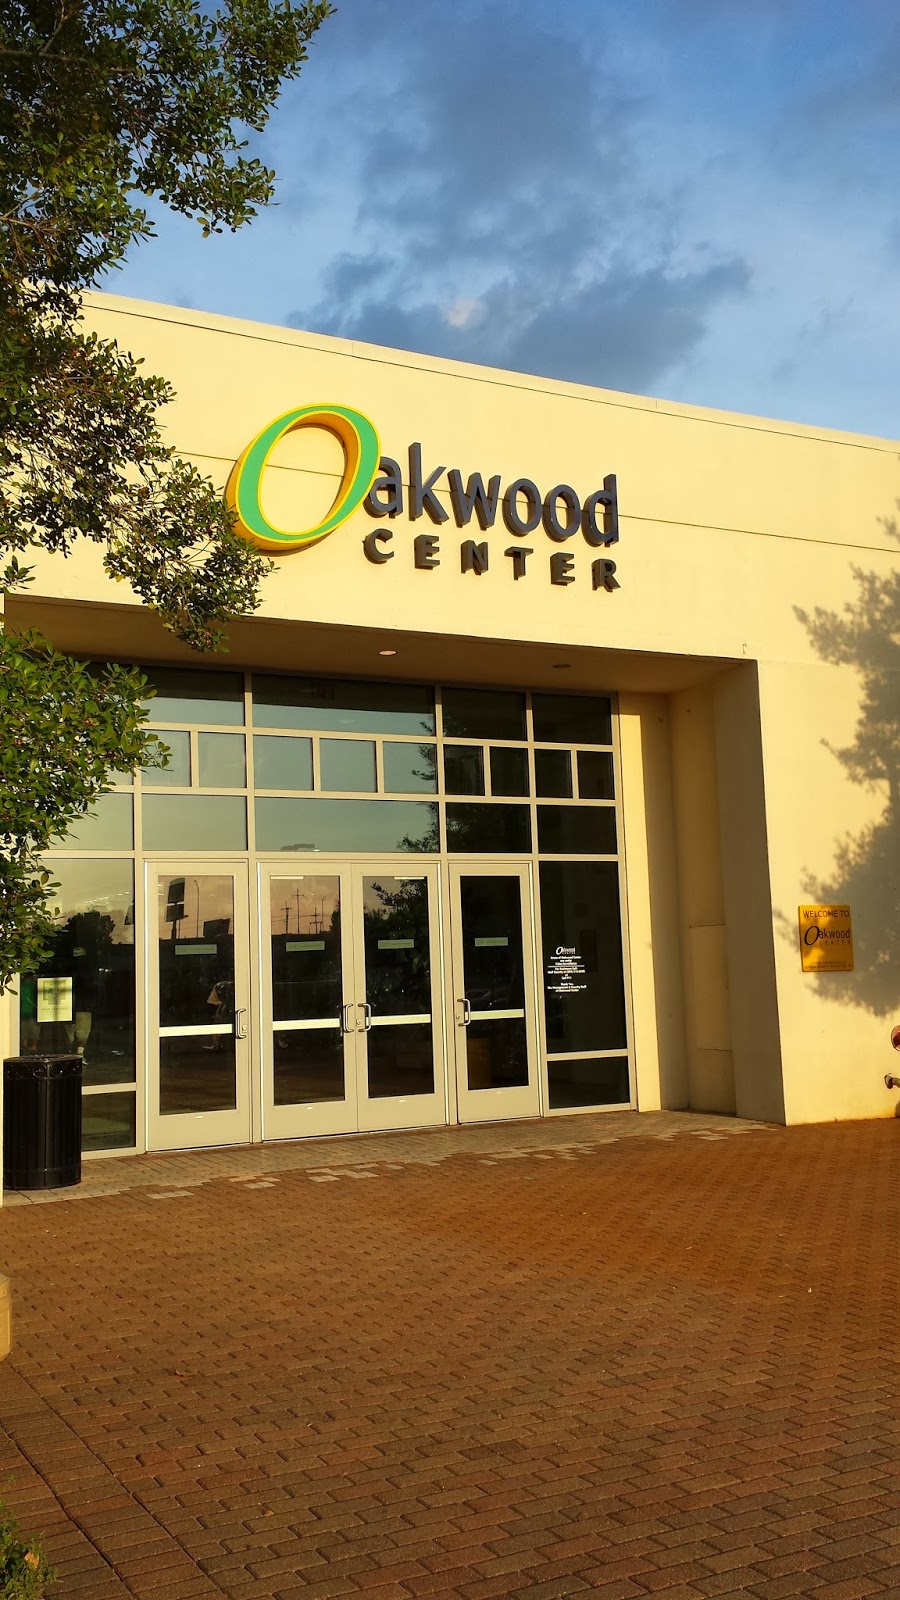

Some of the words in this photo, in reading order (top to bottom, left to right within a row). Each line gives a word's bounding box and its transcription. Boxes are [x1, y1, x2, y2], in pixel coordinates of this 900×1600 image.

[224, 402, 619, 551] Oakwood
[363, 528, 620, 591] CENTER
[803, 910, 838, 918] WELCOME
[804, 926, 851, 946] Oakwood
